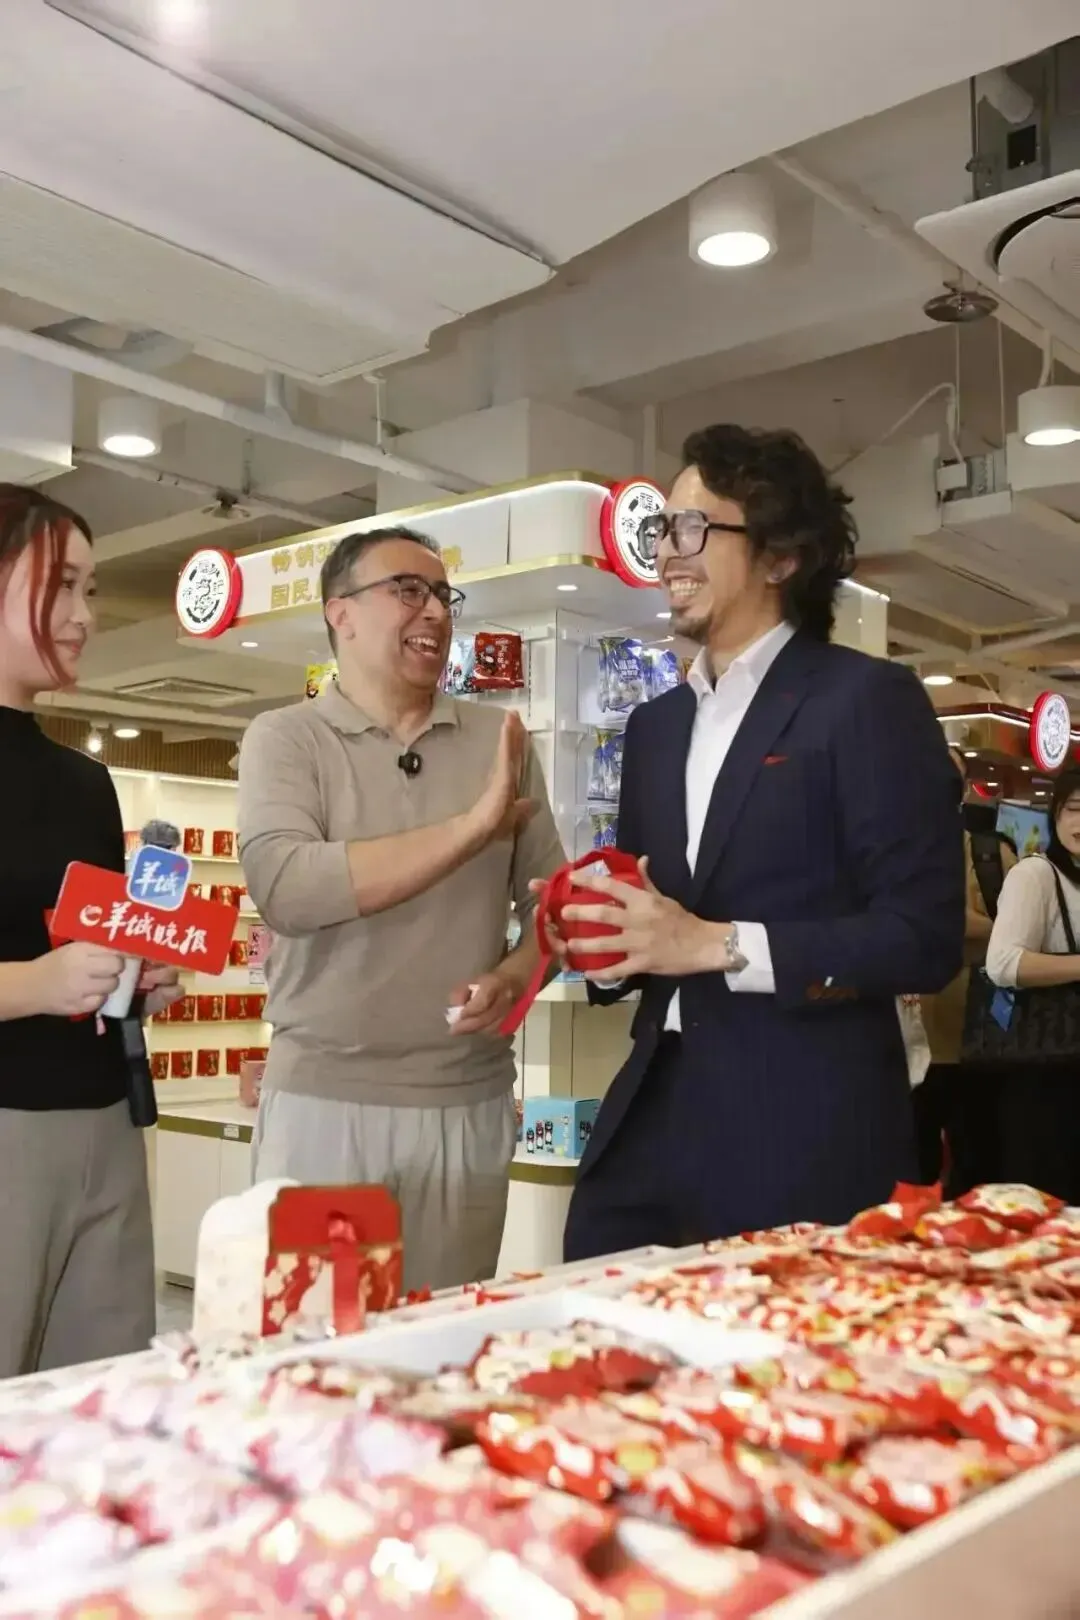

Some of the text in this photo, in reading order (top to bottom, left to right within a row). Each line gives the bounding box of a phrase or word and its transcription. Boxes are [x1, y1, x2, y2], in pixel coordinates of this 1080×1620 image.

[271, 577, 323, 608] 国民
[135, 860, 179, 897] 羊城
[102, 901, 208, 955] 羊城晚报
